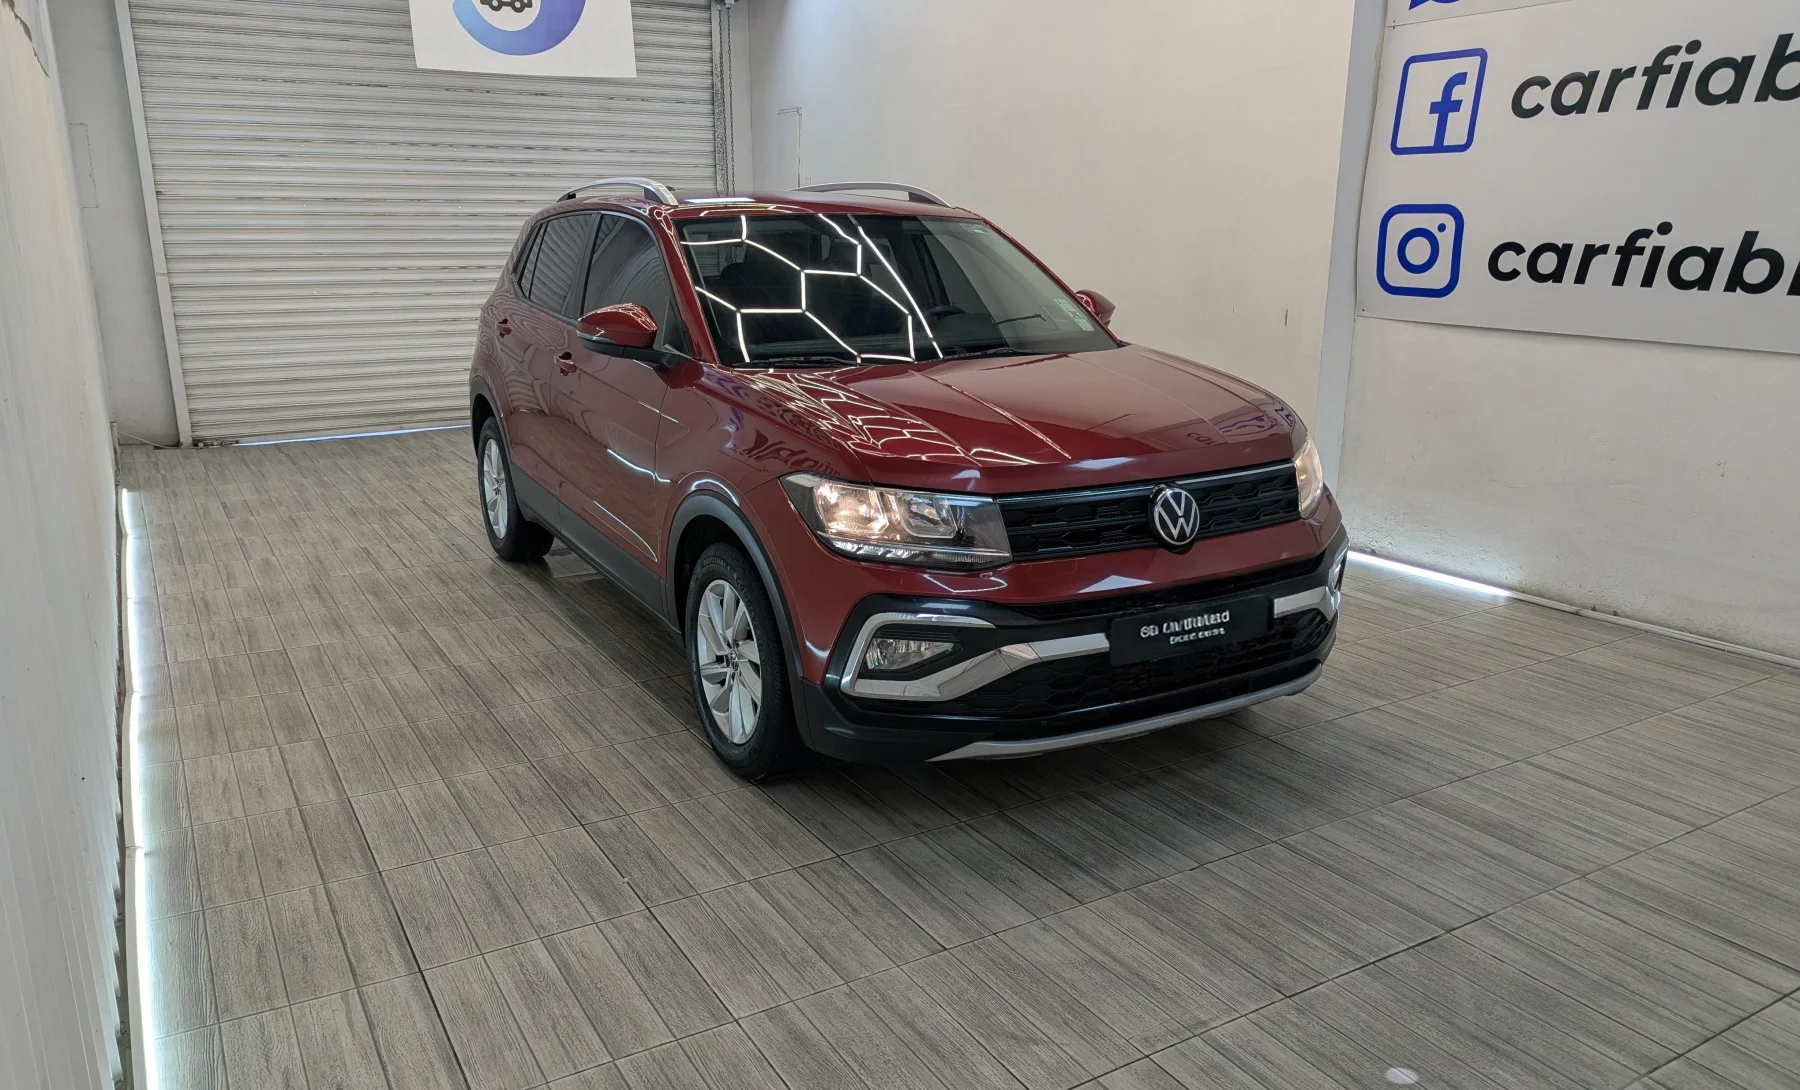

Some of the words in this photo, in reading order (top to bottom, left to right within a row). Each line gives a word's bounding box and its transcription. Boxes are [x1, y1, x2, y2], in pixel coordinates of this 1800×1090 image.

[1510, 33, 1800, 119] carfiab
[1487, 221, 1800, 297] carfiab
[1156, 489, 1198, 543] VW
